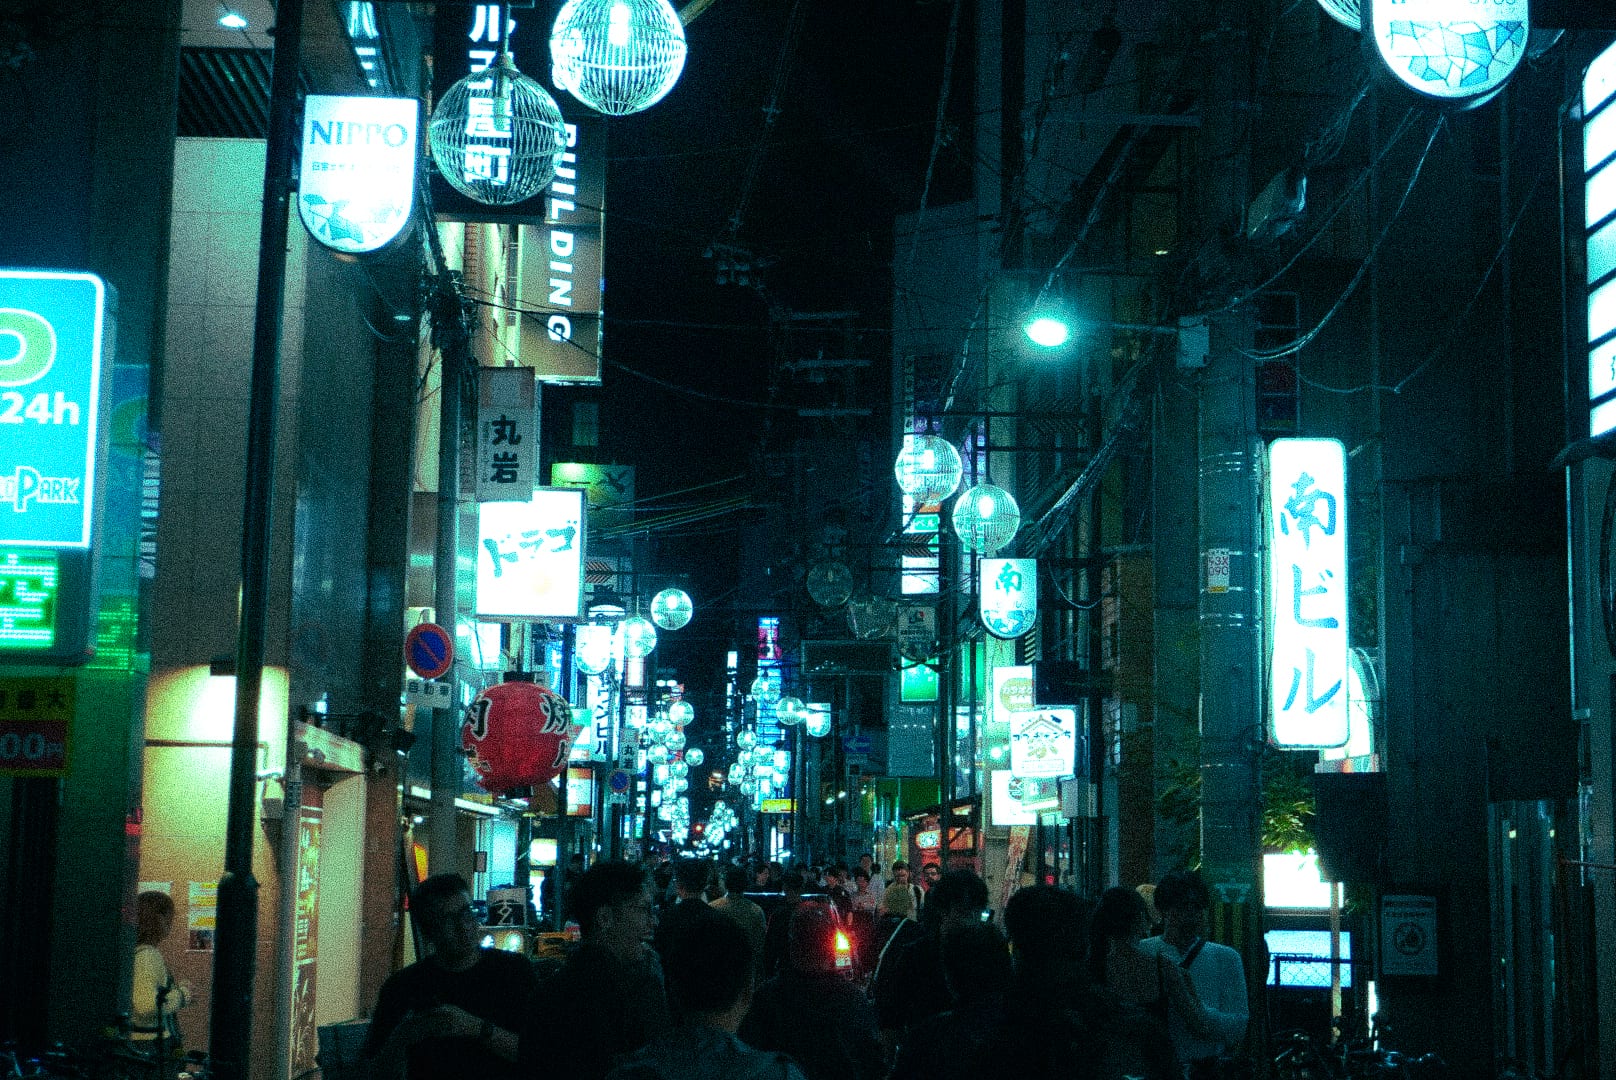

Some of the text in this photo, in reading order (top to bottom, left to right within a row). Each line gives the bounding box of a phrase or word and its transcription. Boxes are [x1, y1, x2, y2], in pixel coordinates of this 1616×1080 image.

[309, 119, 409, 147] NIPPO
[547, 122, 578, 343] BUILDING
[0, 390, 80, 425] 24h
[489, 413, 523, 484] 丸岩
[995, 561, 1023, 597] 南
[1280, 471, 1342, 714] 南ビル
